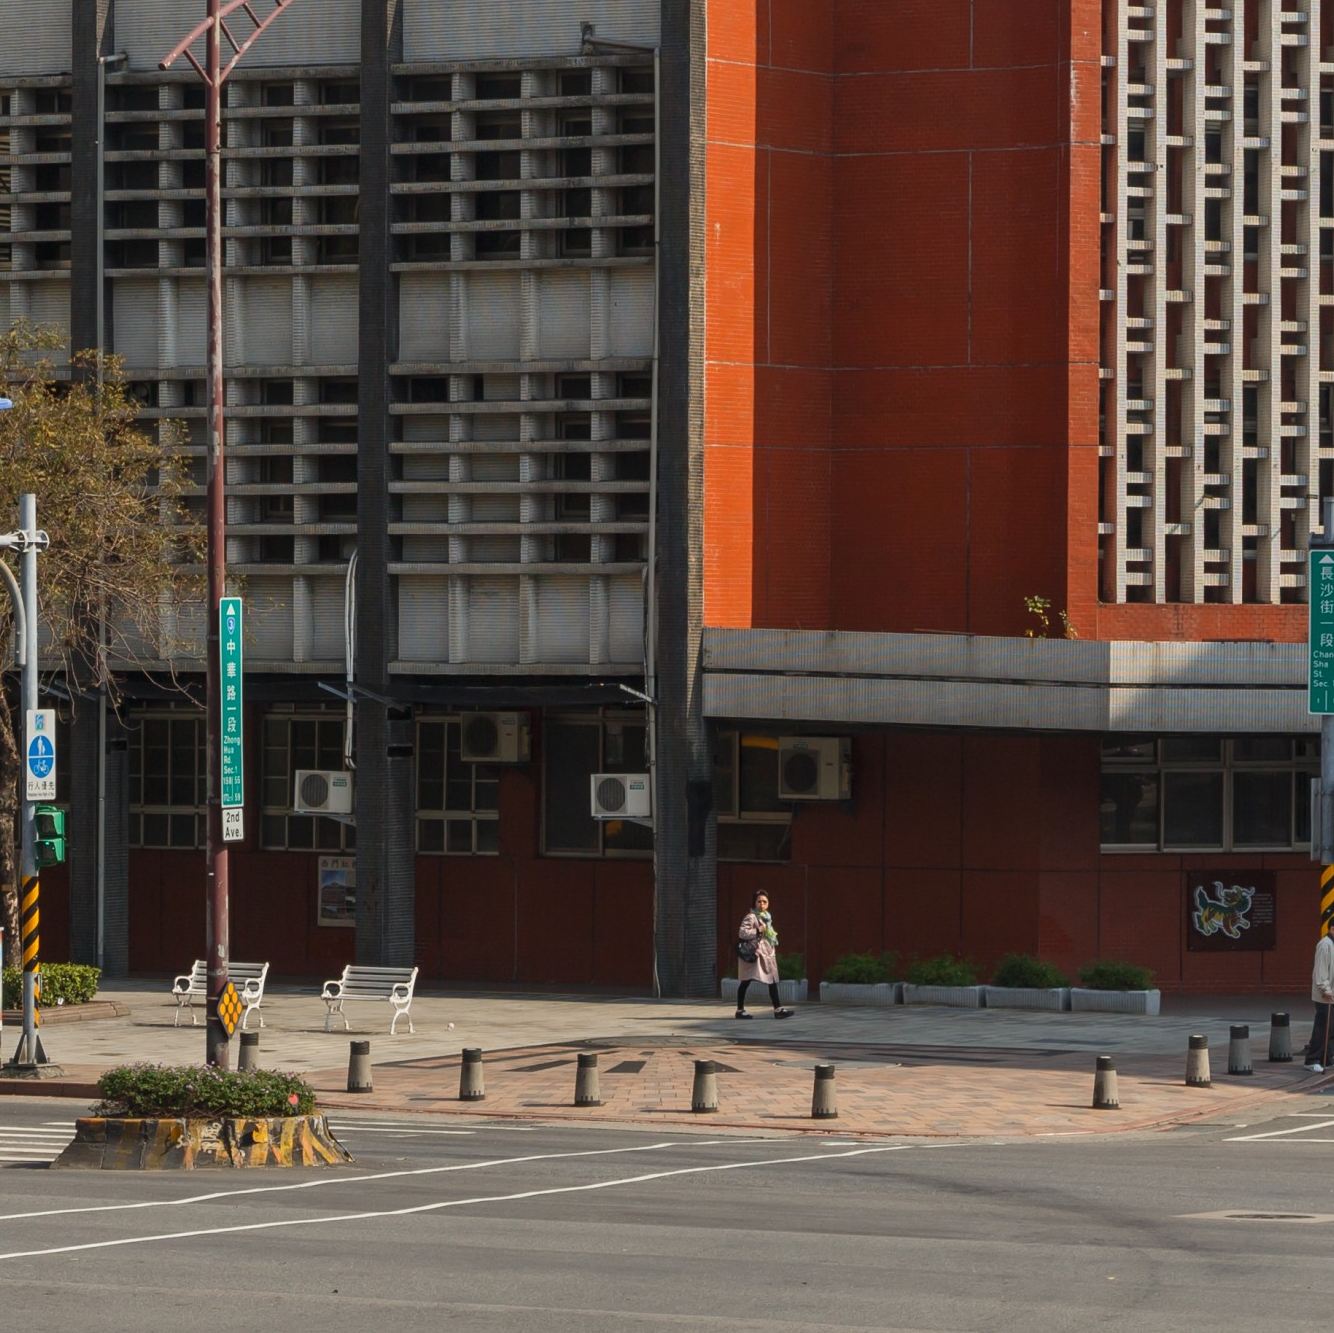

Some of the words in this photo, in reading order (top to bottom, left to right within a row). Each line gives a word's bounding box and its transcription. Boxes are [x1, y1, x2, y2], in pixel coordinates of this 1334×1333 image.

[1320, 566, 1334, 648] 長沙街一段
[226, 638, 236, 733] 中華路一段
[224, 736, 241, 746] Zhong
[226, 812, 240, 822] 2nd
[225, 828, 242, 838] Ave.
